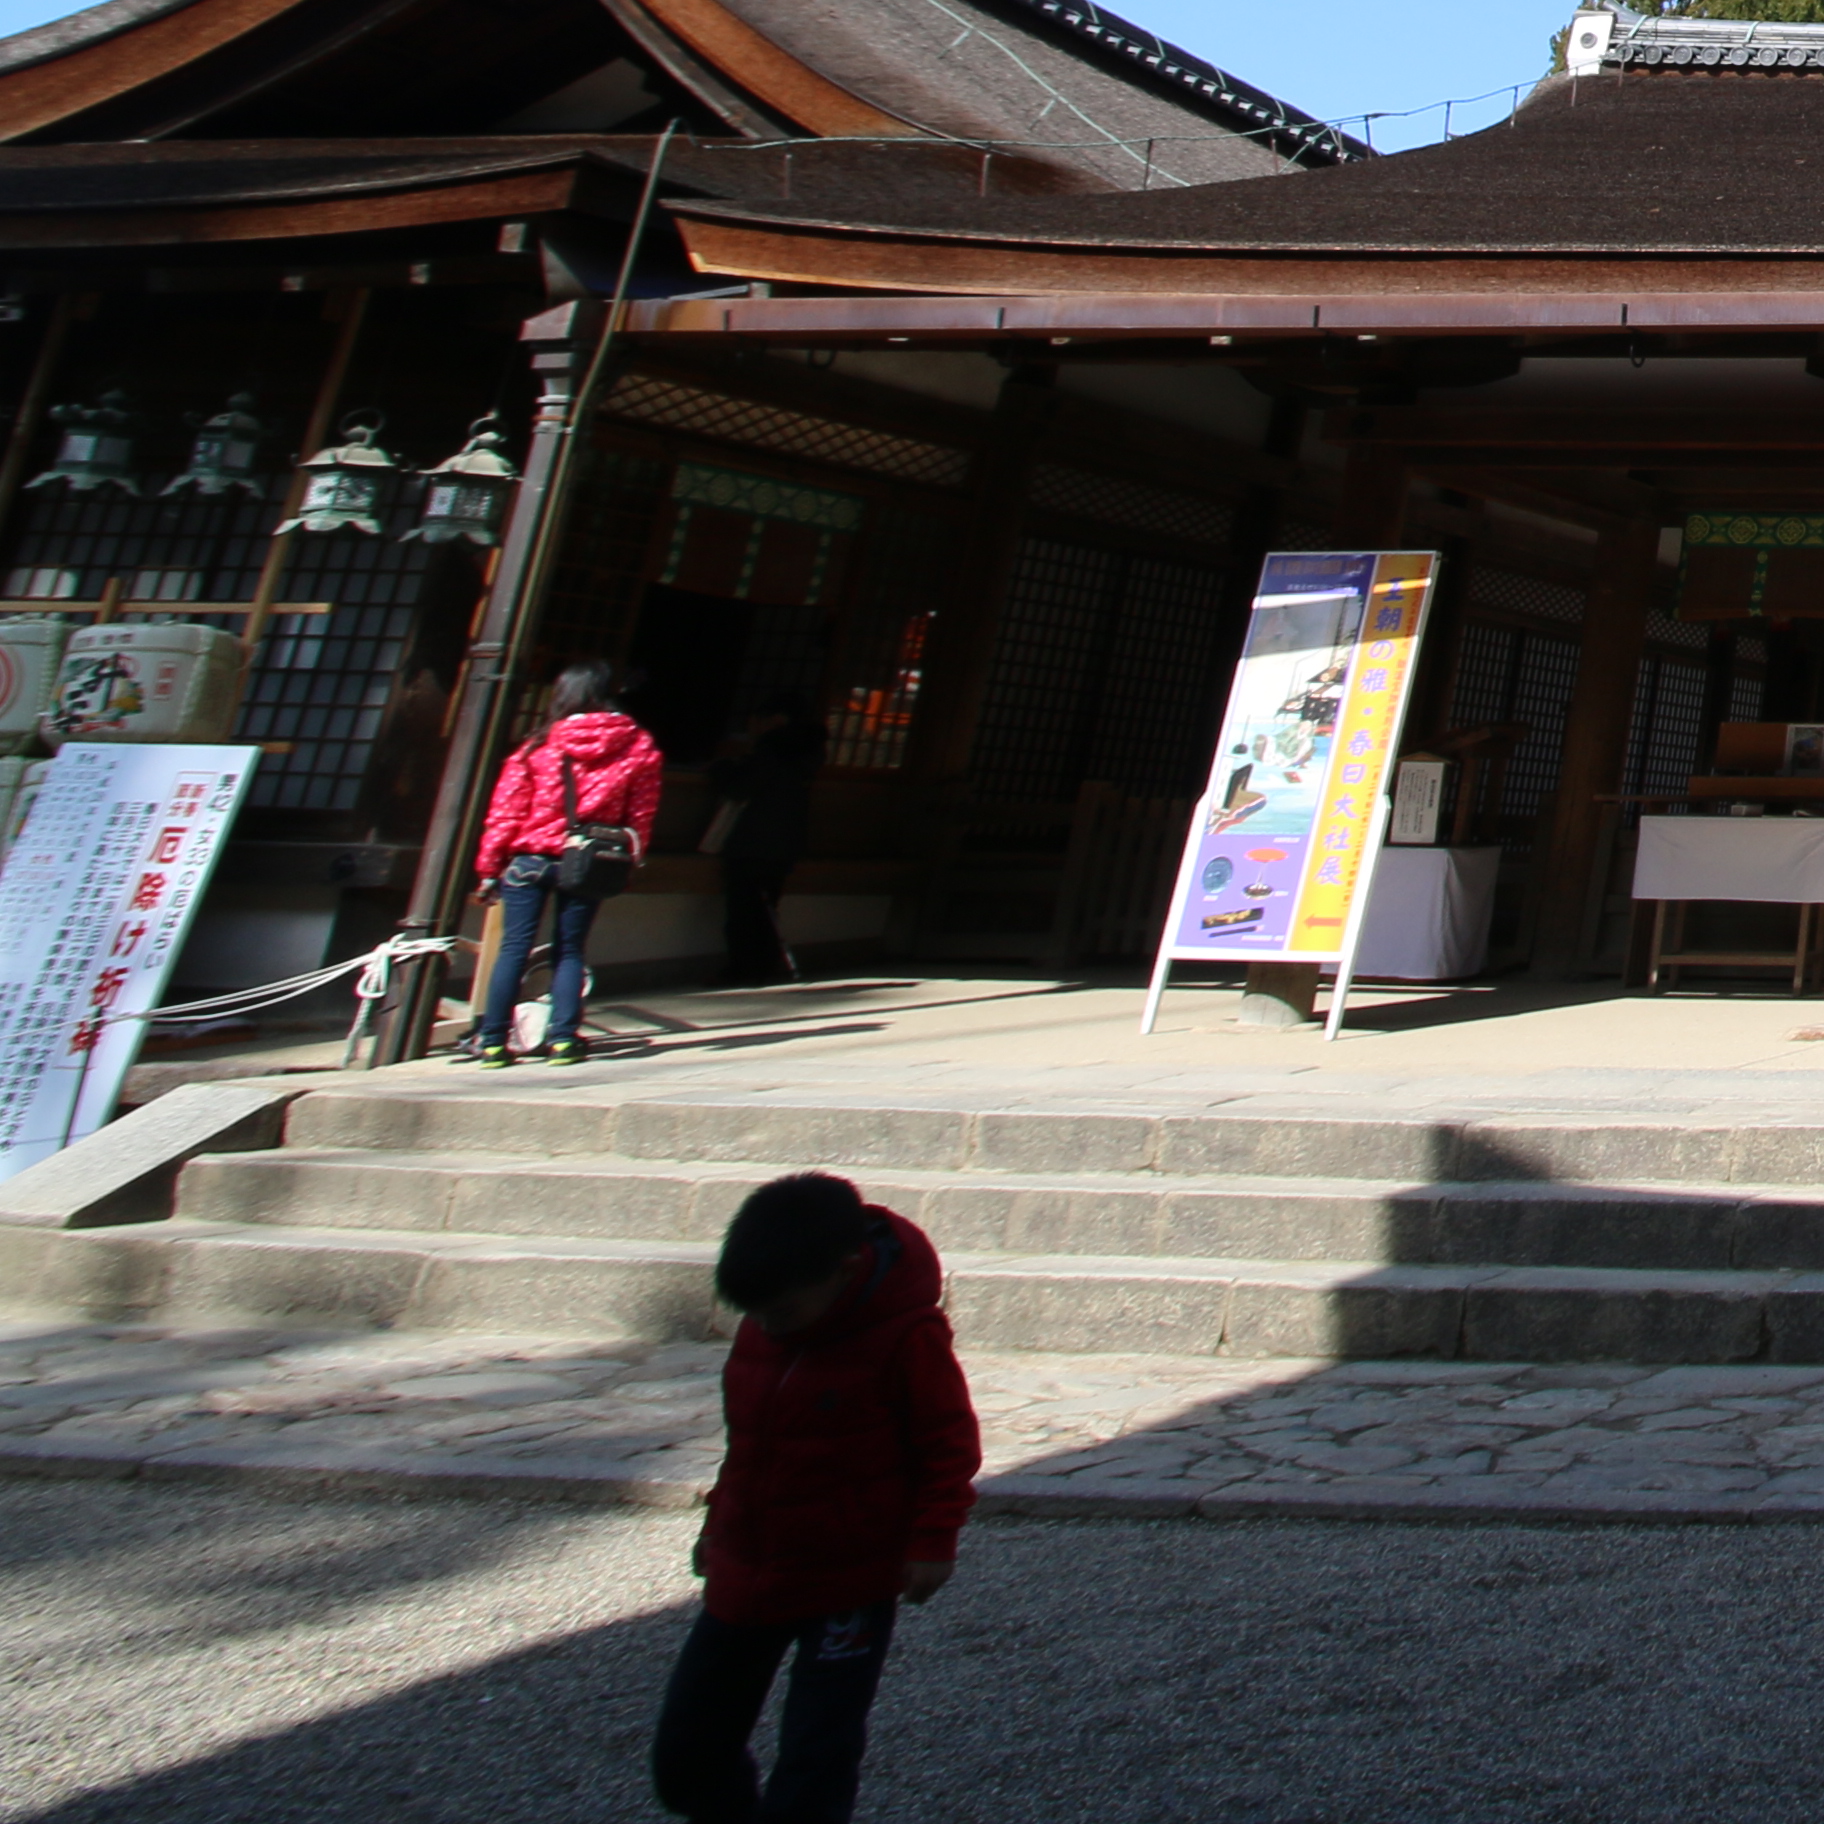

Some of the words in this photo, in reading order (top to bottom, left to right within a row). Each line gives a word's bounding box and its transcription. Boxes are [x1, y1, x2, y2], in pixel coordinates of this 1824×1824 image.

[1313, 577, 1405, 886] 王朝の雅・春日大社展
